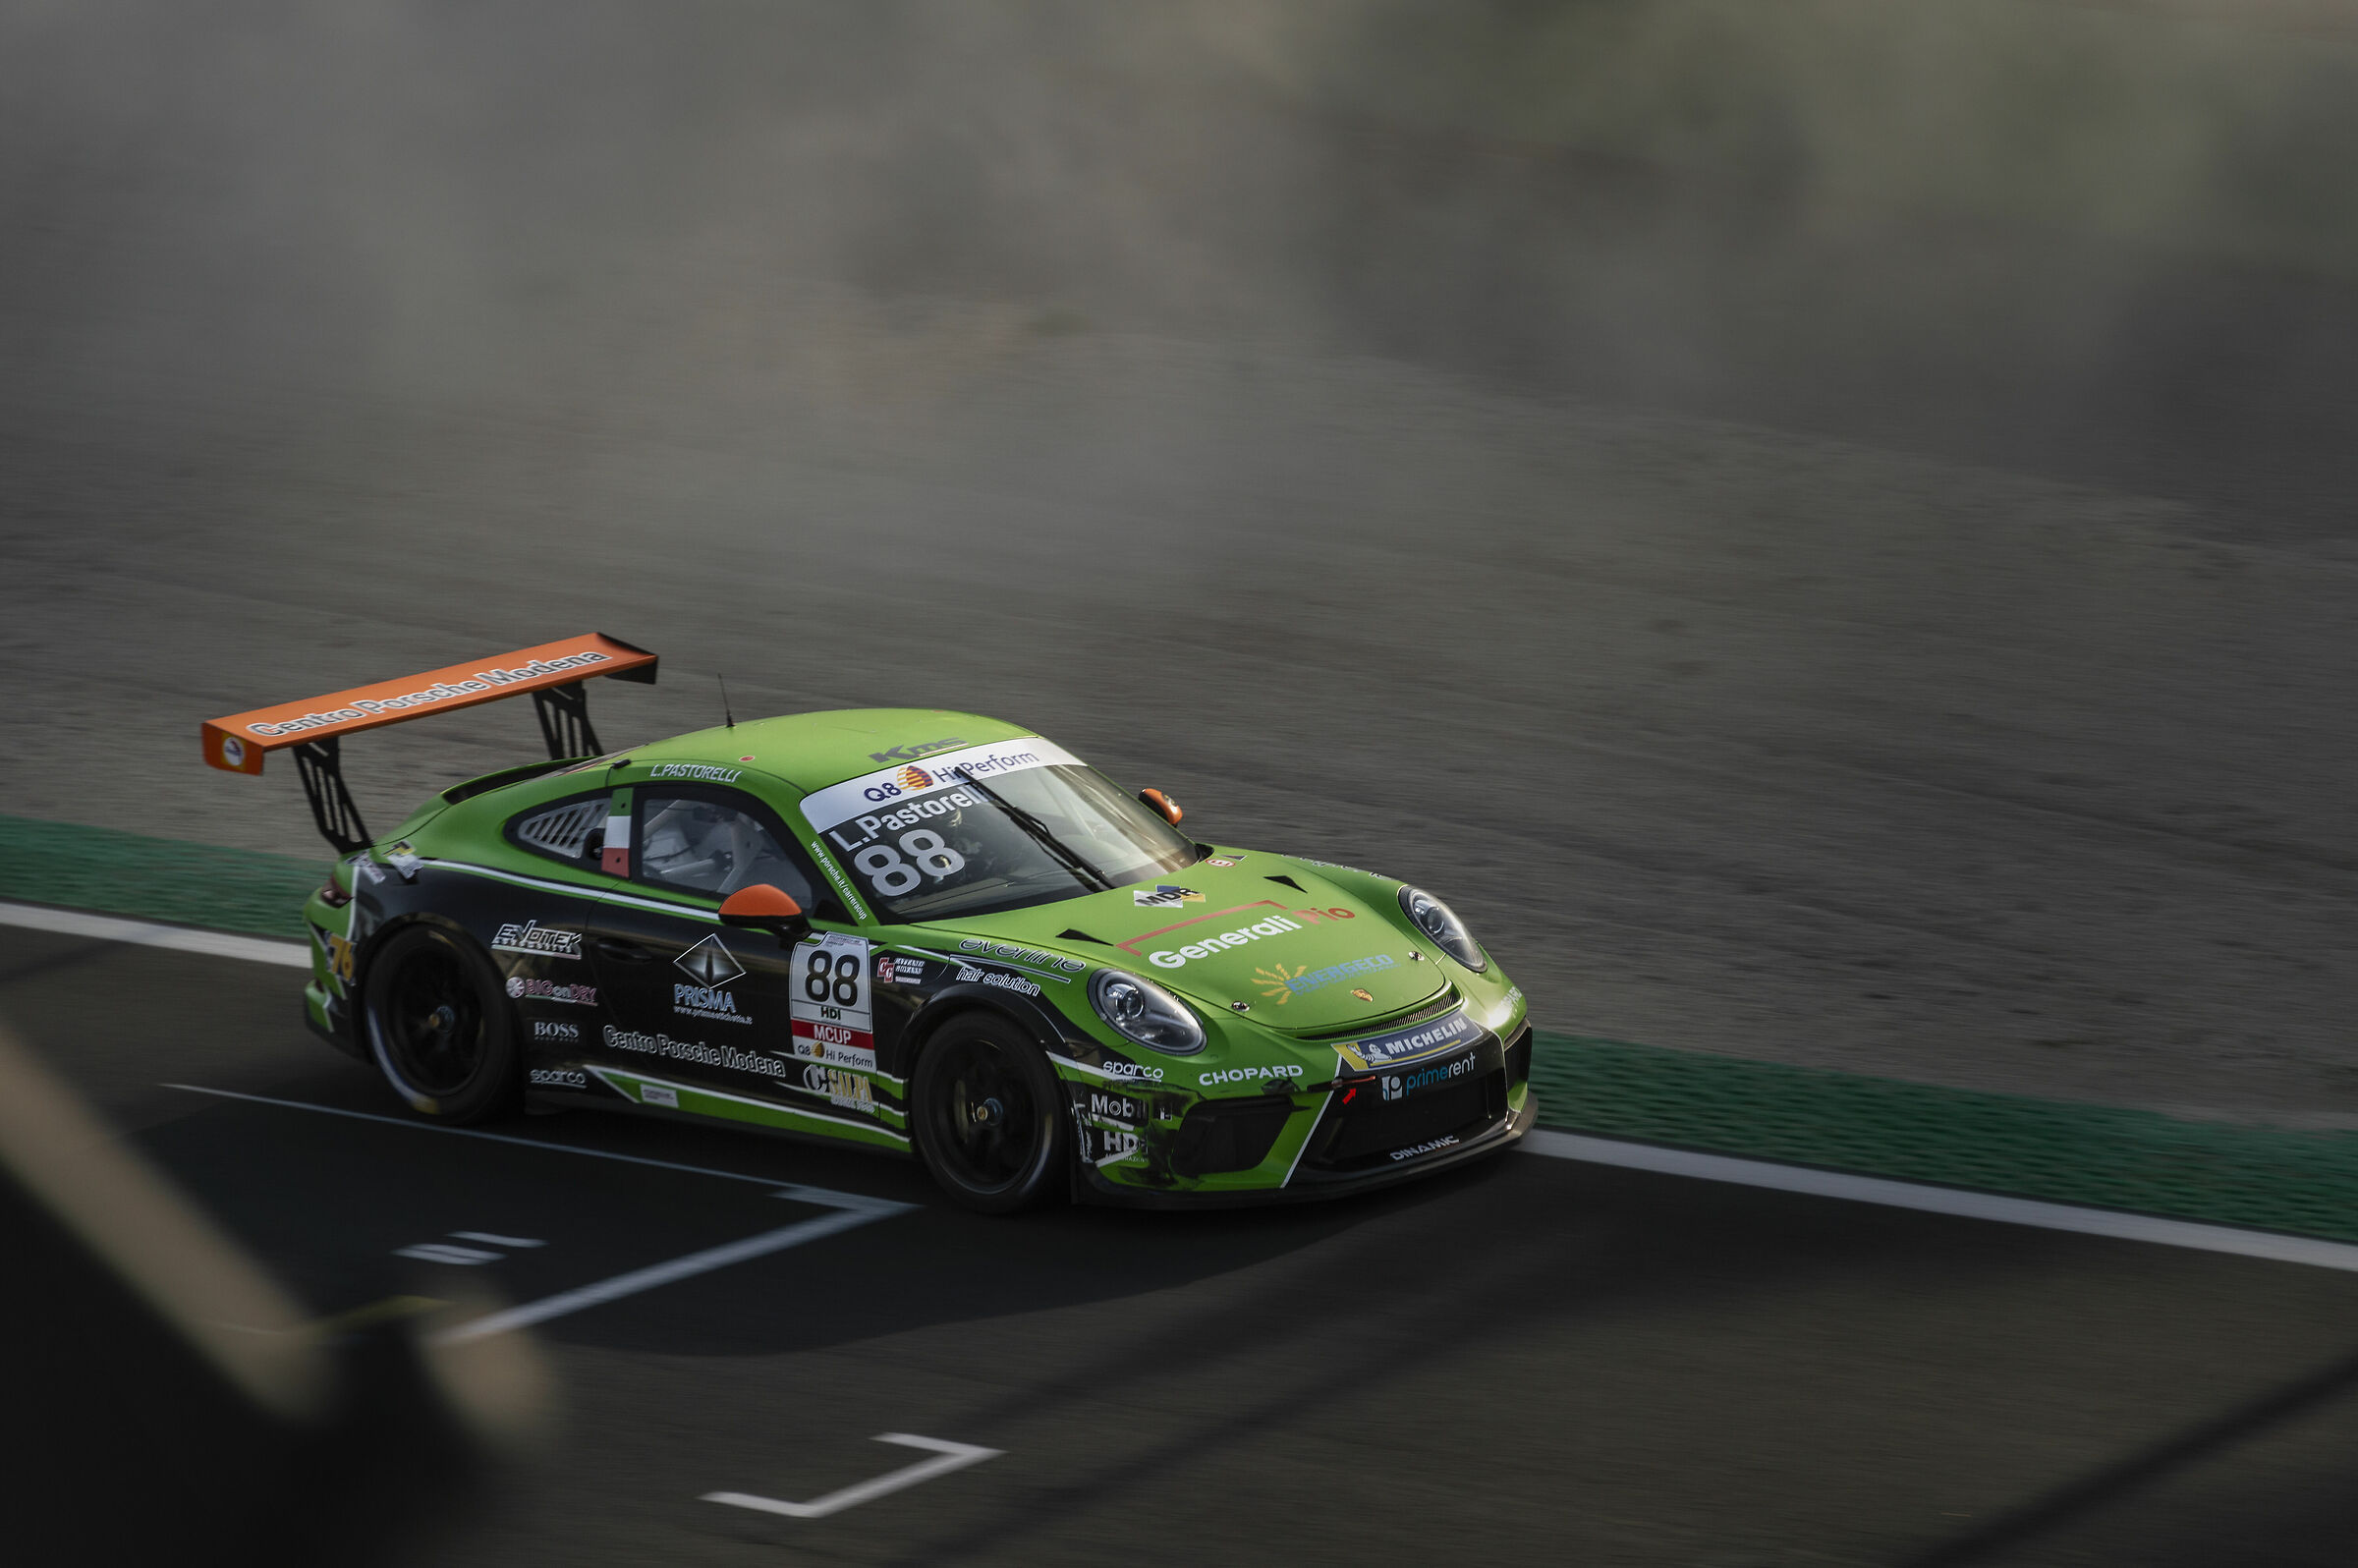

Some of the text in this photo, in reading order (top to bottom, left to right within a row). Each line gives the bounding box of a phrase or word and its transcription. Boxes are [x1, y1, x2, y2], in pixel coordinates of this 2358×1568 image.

[247, 651, 613, 737] Centro Porsche Modena
[649, 763, 742, 783] L.PASTORELLI
[864, 782, 902, 802] Q8
[959, 753, 1040, 776] Perform
[828, 784, 994, 852] L.Pastorell
[854, 828, 965, 896] 88
[811, 840, 868, 920] www.porsche.it/carreracup
[1136, 888, 1201, 907] MDR
[1149, 908, 1356, 969] Generali Pio
[806, 950, 860, 1007] 88
[956, 968, 1041, 997] hair solution
[674, 983, 737, 1014] PRISMA
[820, 1006, 841, 1021] HDI
[534, 1021, 580, 1038] BOSS
[814, 1024, 852, 1044] MCUP
[1385, 1018, 1467, 1055] MICHELIN
[603, 1025, 786, 1078] Centro Porsche Modena
[797, 1044, 872, 1068] Q8 Hi Perform
[530, 1069, 587, 1085] sparco
[1103, 1061, 1164, 1079] sparco
[1199, 1065, 1304, 1086] CHOPARD
[1406, 1052, 1476, 1095] primerent
[1390, 1136, 1460, 1160] DINAMIC
